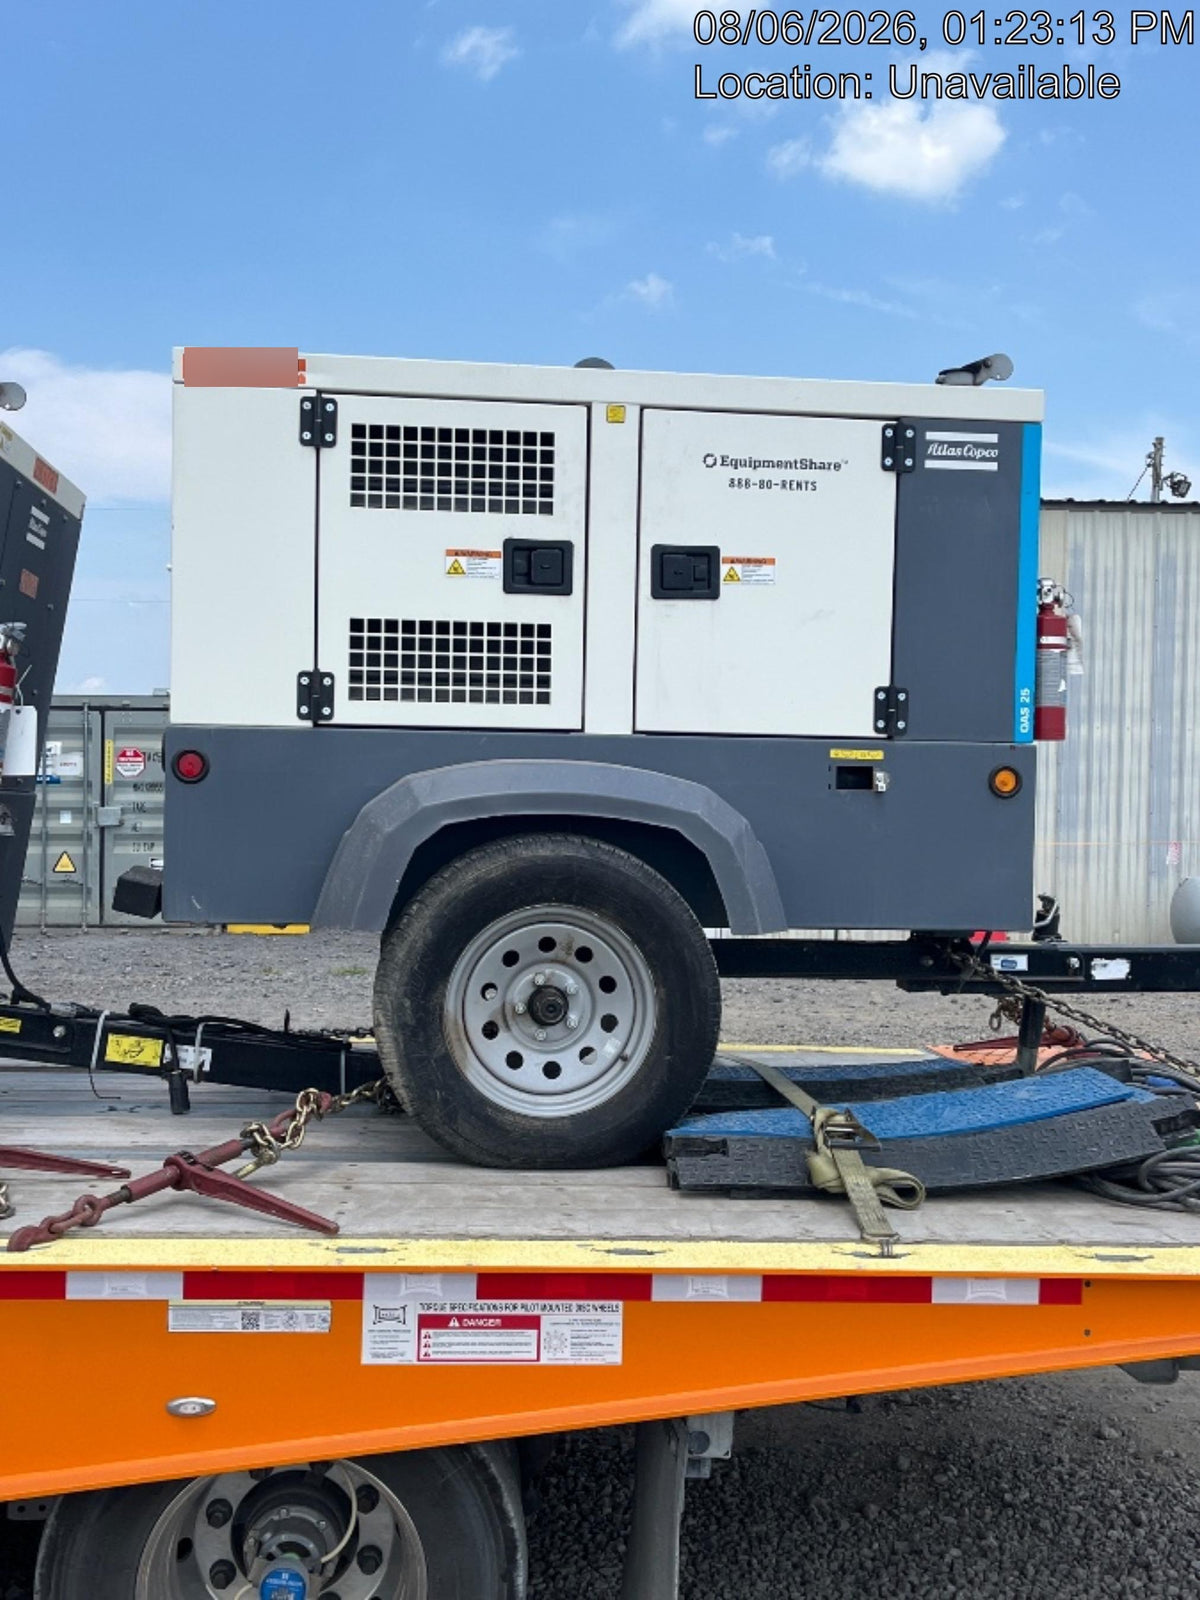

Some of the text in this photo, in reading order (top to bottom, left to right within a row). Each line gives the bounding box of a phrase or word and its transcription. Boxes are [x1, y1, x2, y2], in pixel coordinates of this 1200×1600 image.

[927, 442, 999, 459] Atlas Copco
[728, 477, 818, 492] 888-80-RENTS
[1019, 688, 1031, 734] QAS 25
[462, 1318, 503, 1327] DANGER
